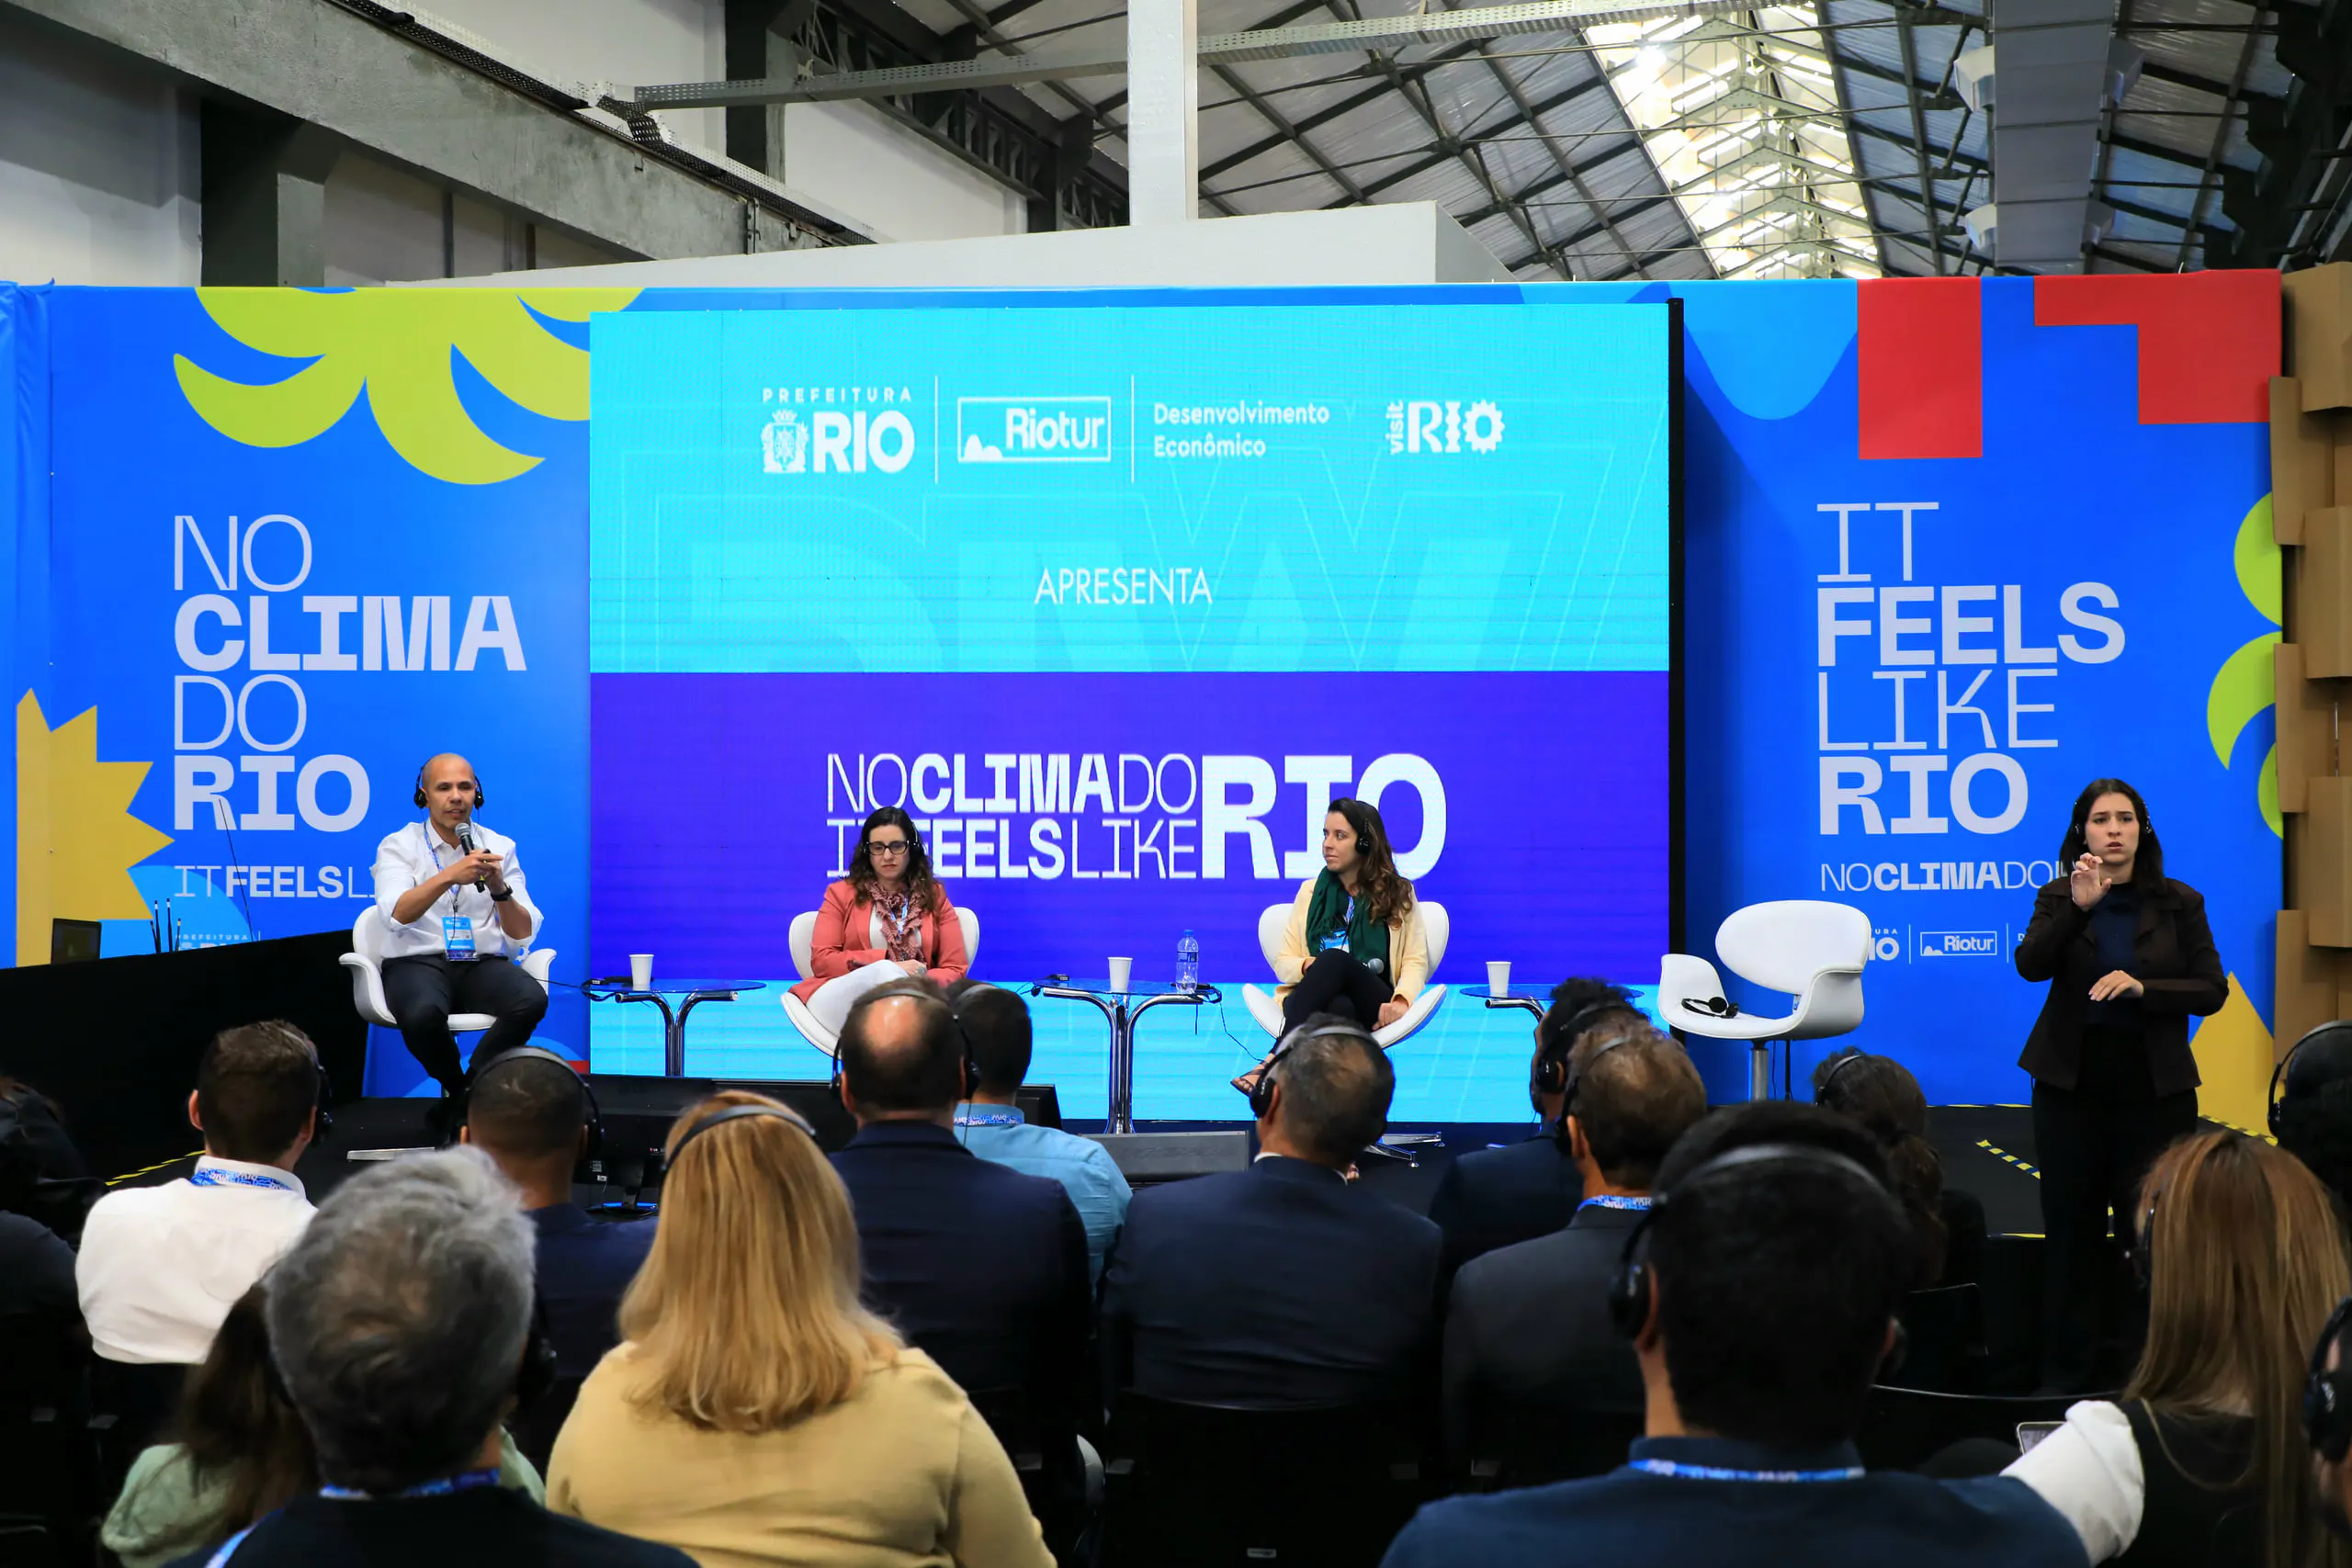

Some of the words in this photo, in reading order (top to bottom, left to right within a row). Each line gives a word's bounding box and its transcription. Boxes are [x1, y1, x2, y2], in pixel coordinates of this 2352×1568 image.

[763, 387, 912, 403] PREFEITURA
[1006, 407, 1105, 450] Riotur
[1154, 400, 1330, 425] Desenvolvimento
[1385, 399, 1404, 455] visit
[1407, 399, 1506, 455] RIO
[813, 410, 916, 474] RIO
[1154, 432, 1267, 457] Econômico
[174, 513, 313, 592] NO
[1816, 502, 1939, 582] IT
[1034, 567, 1213, 606] APRESENTA
[1817, 581, 2126, 667] FEELS
[174, 593, 527, 671] CLIMA
[174, 673, 307, 752] DO
[1818, 668, 2059, 751] LIKE
[174, 754, 370, 832] RIO
[1202, 752, 1448, 881] RIO
[1819, 752, 2029, 835] RIO
[1943, 934, 1995, 953] Riotur
